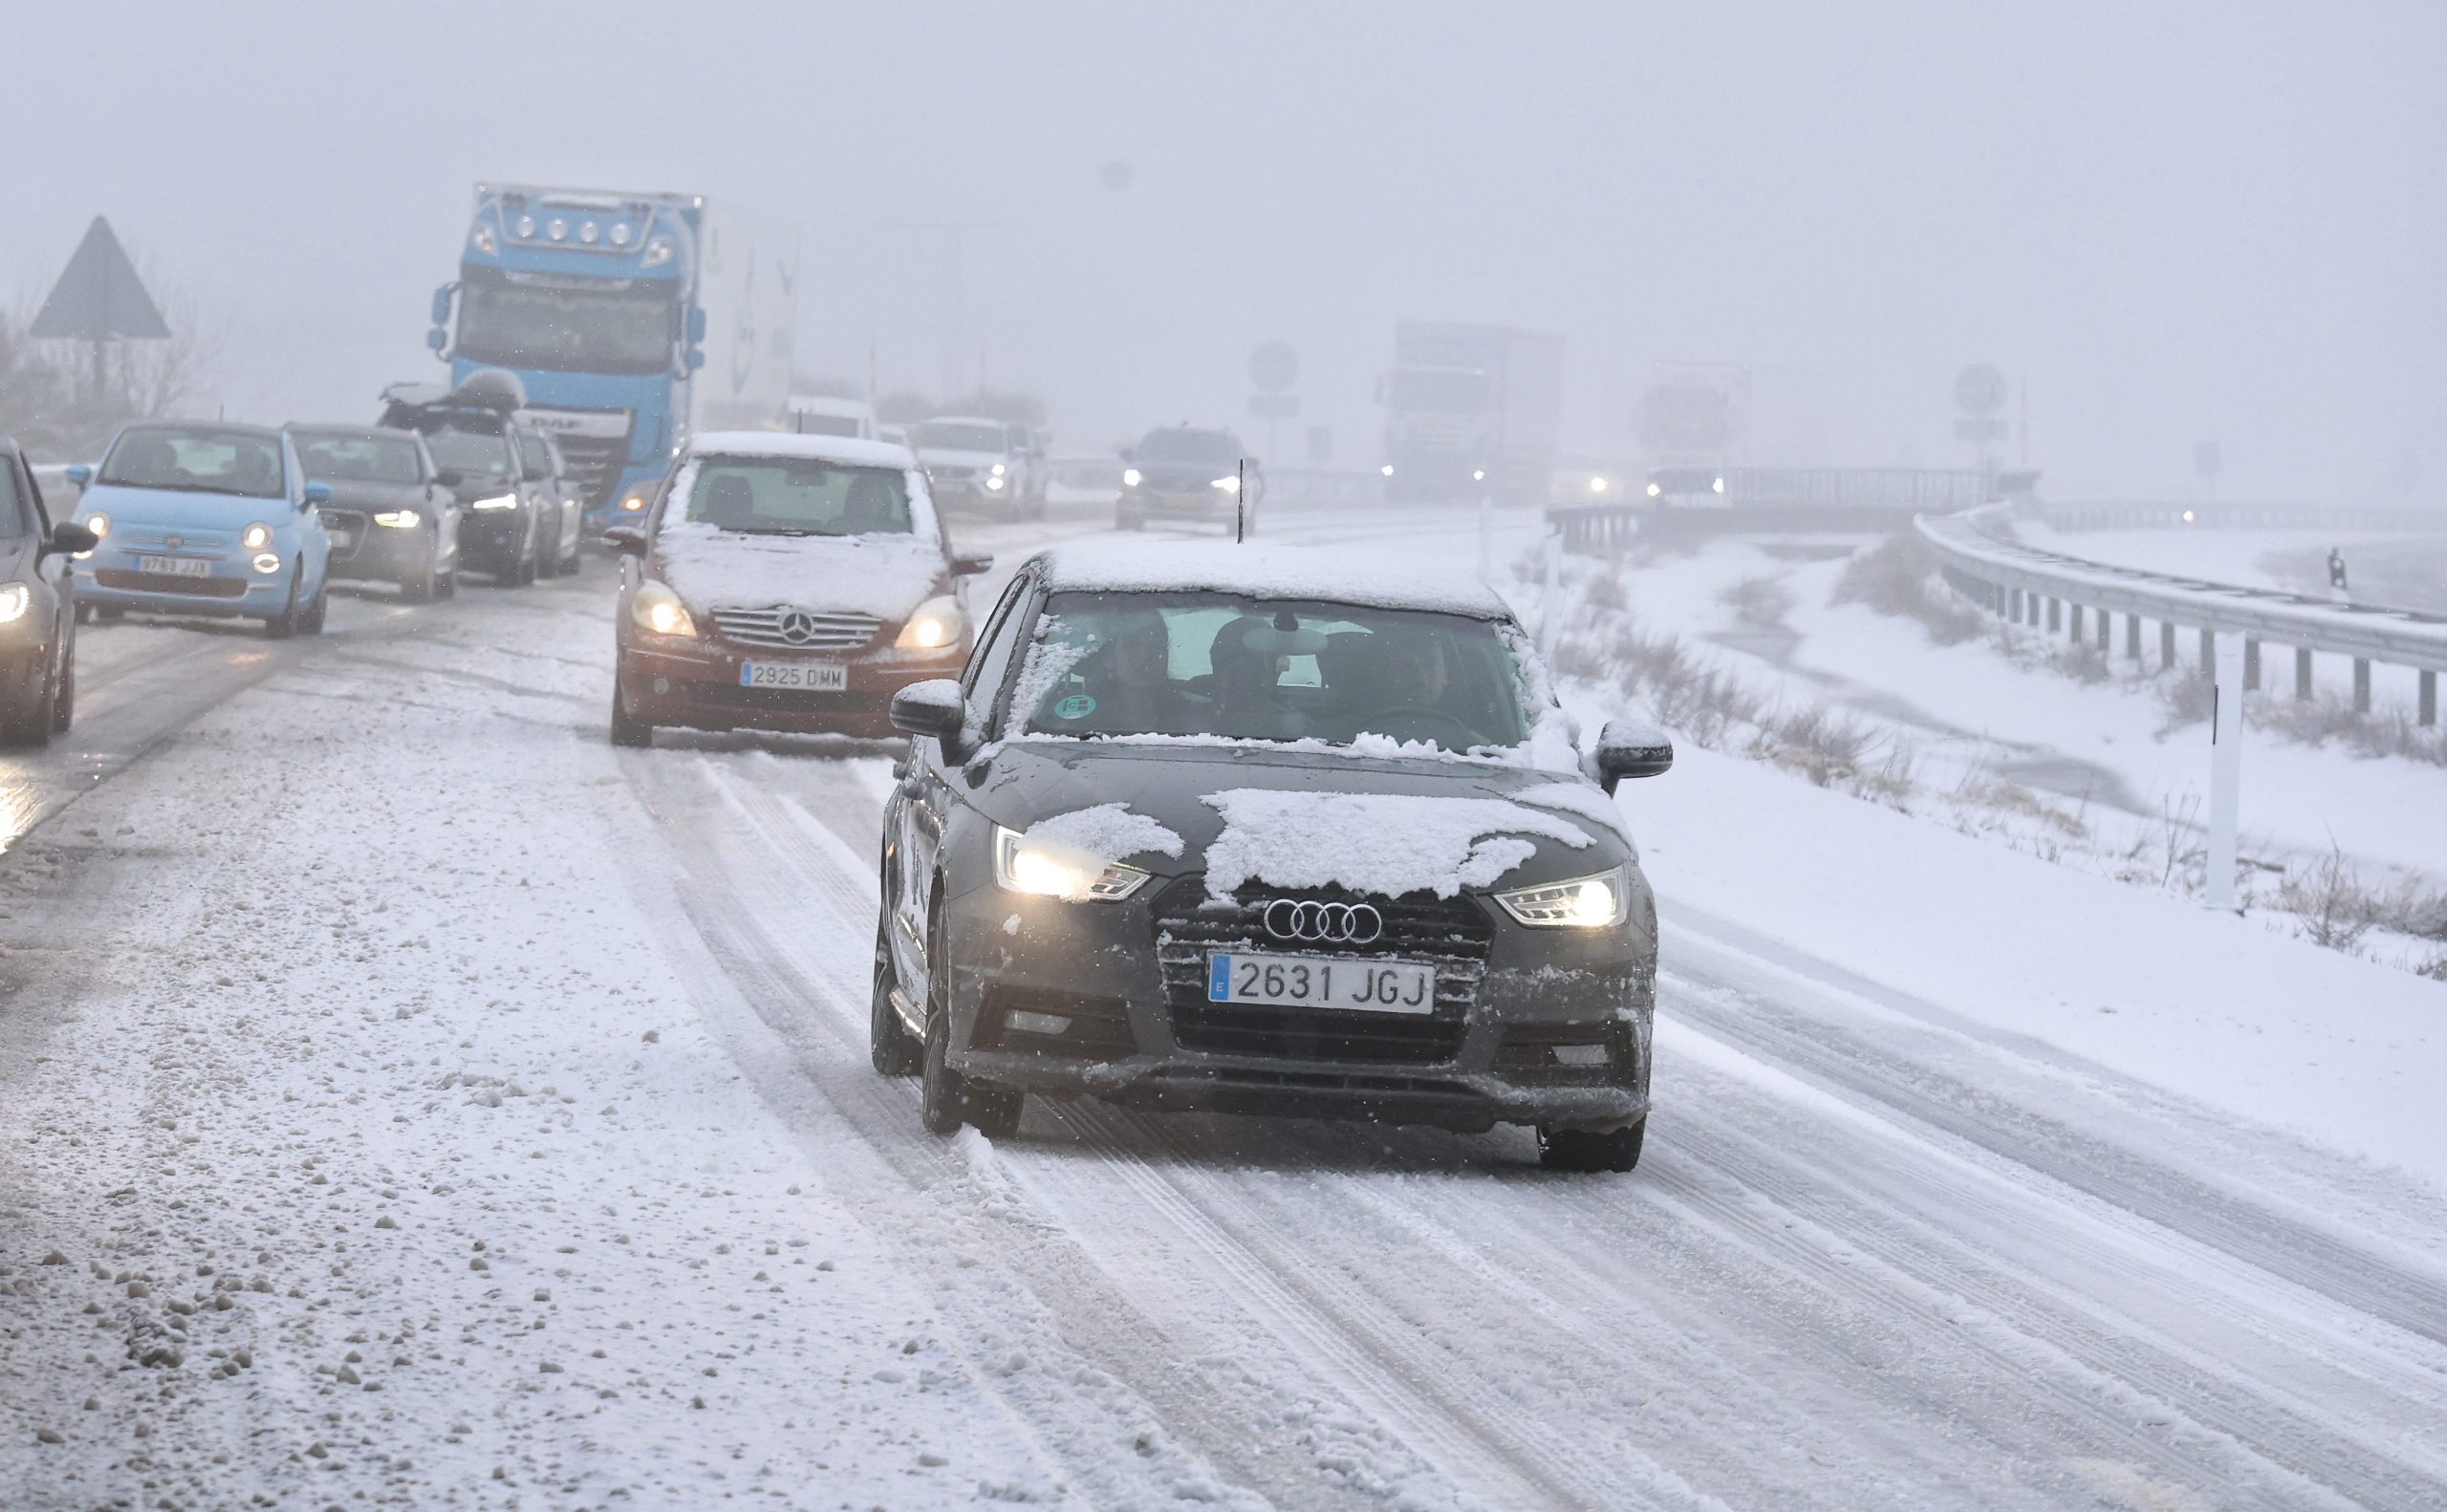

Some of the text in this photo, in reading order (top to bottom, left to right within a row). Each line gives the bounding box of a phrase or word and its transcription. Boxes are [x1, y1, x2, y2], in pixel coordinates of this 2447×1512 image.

[753, 666, 801, 685] 2925
[806, 669, 842, 687] DMM
[1215, 961, 1425, 1007] E 2631 JGJ
